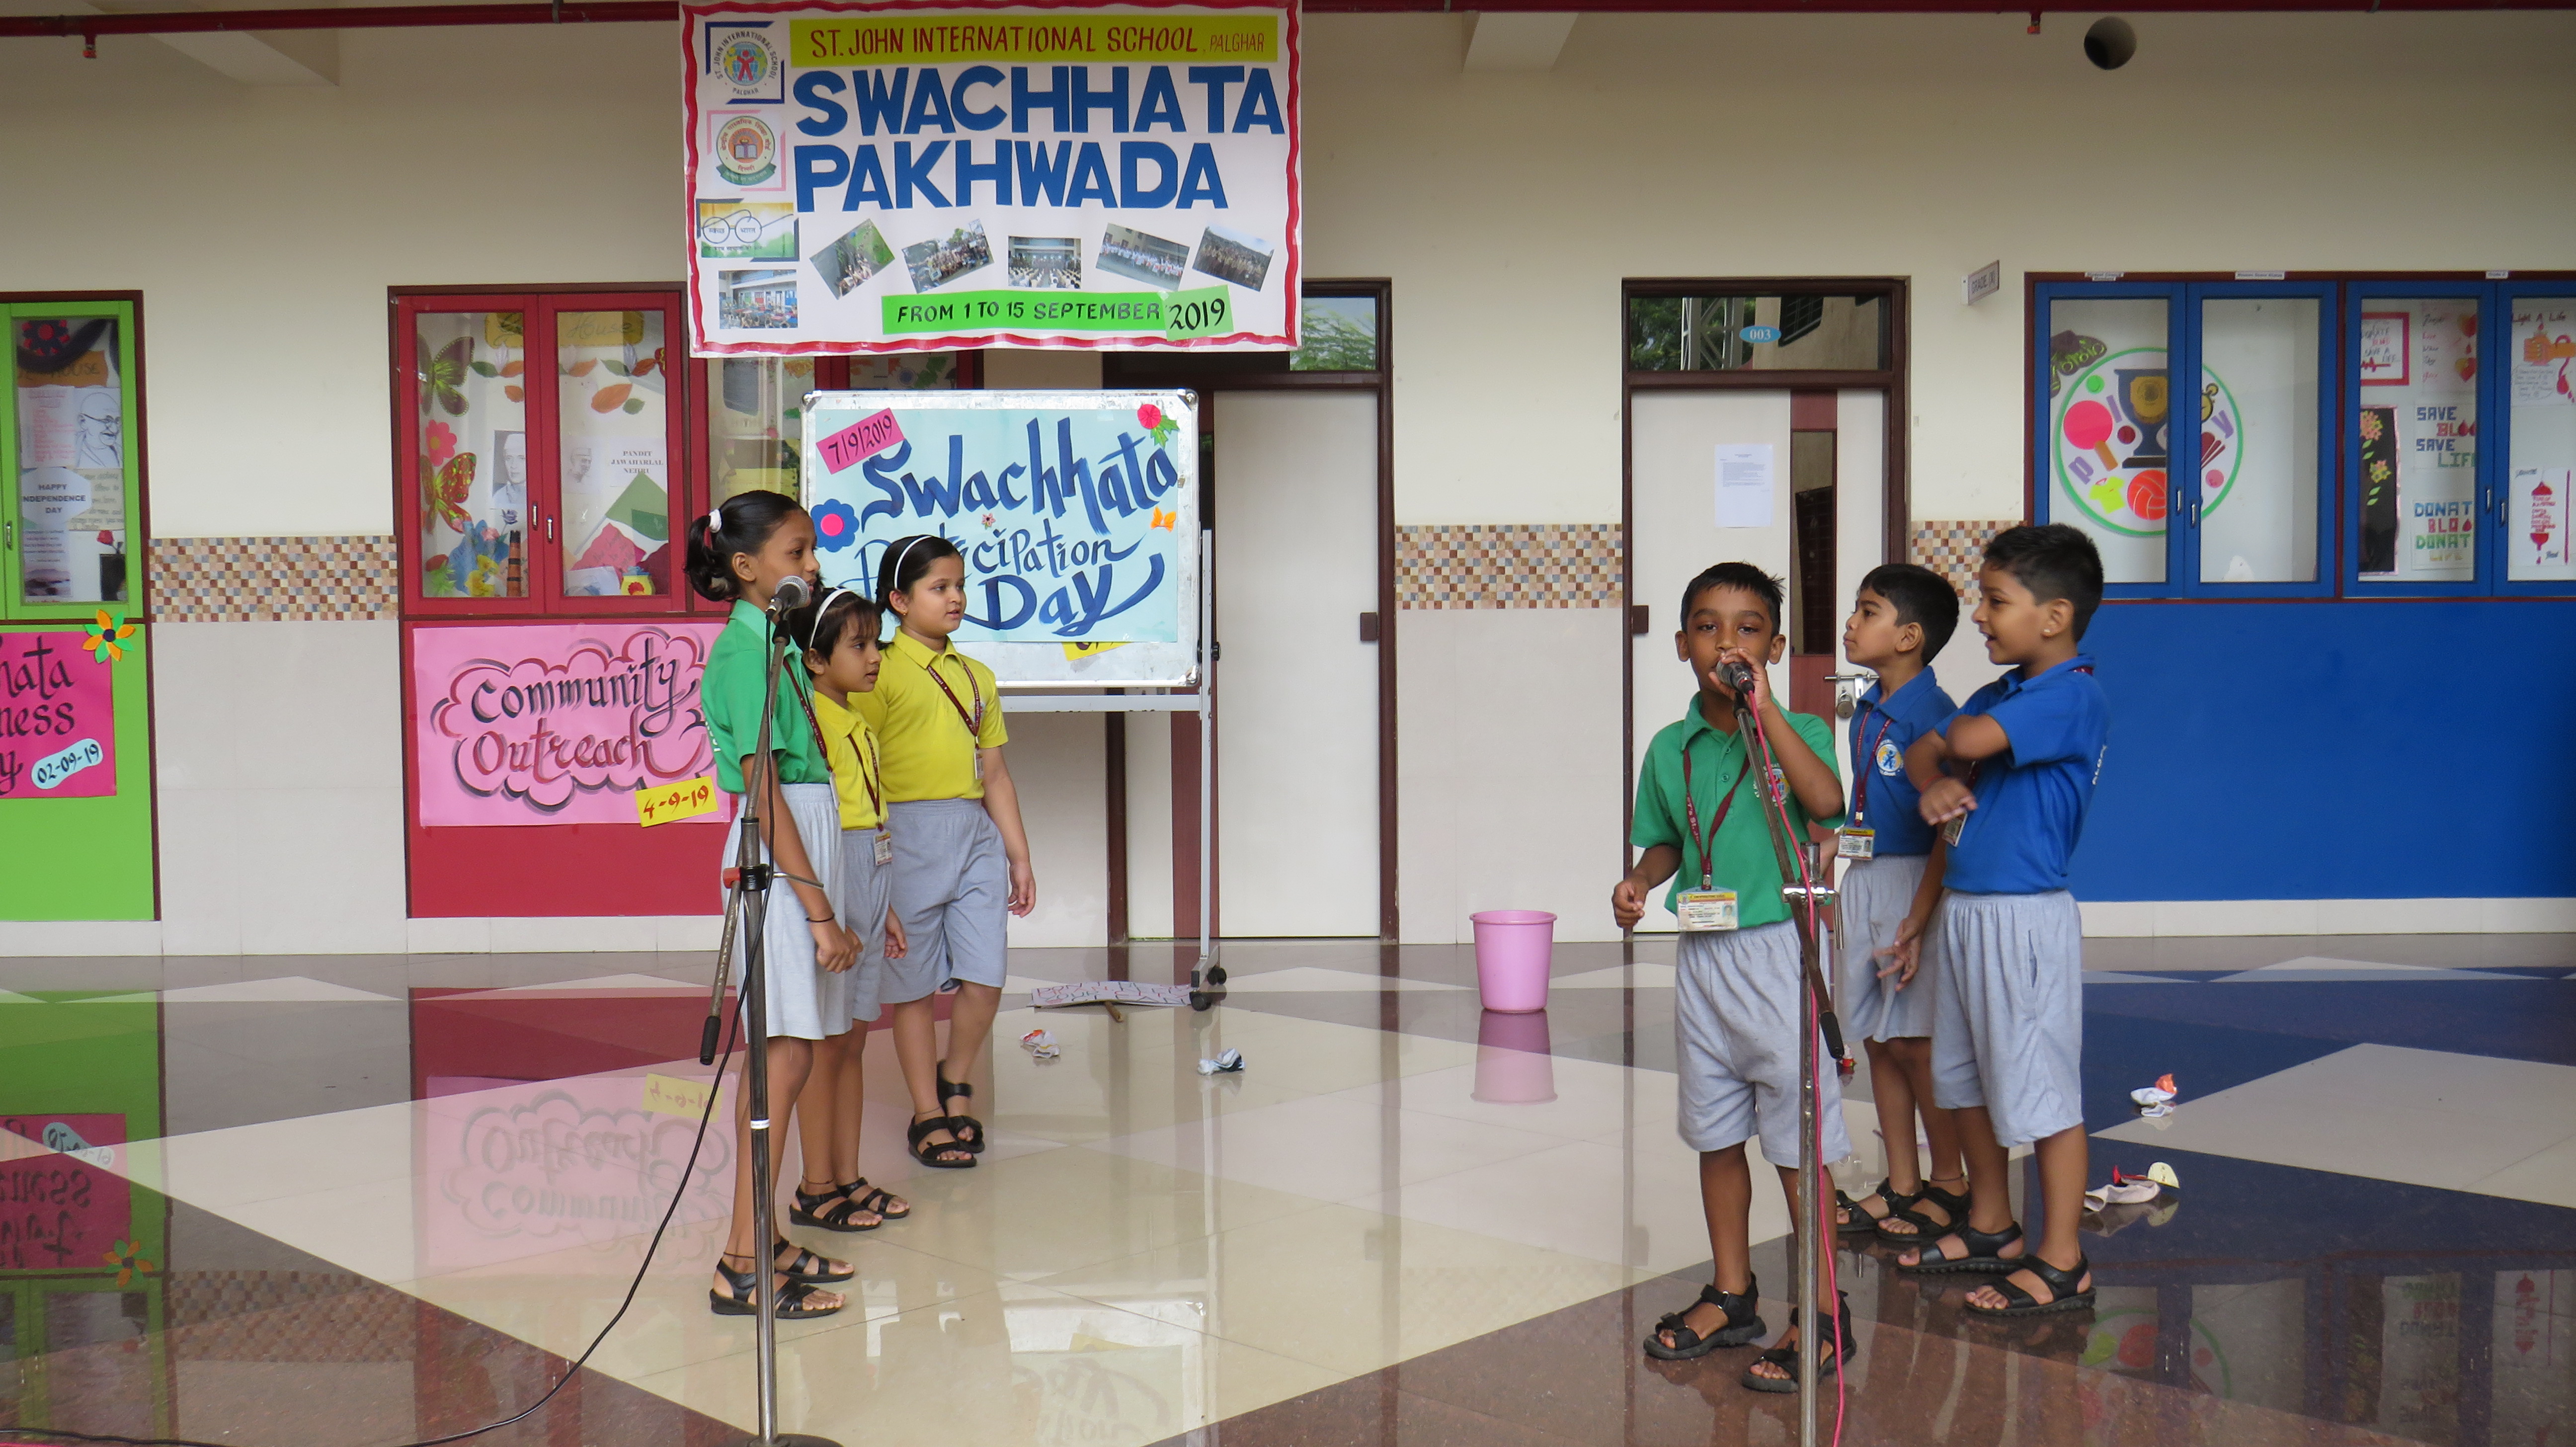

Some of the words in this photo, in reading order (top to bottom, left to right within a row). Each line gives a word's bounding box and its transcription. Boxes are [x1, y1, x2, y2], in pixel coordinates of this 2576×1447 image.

[713, 46, 724, 66] JOHN
[722, 31, 771, 51] INTERNATIONAL
[769, 51, 779, 79] SCHOOL
[810, 30, 844, 57] ST.
[848, 28, 904, 55] JOHN
[912, 26, 1096, 54] INTERNATIONAL
[1209, 33, 1266, 54] PALGHAR
[732, 87, 759, 96] PALGHAR
[793, 65, 1285, 137] SWACHHATA
[795, 139, 1229, 213] PAKHWADA
[897, 304, 954, 323] FROM
[964, 303, 970, 320] 1
[976, 301, 999, 318] TO
[1006, 301, 1024, 318] 15
[1033, 302, 1160, 321] SEPTEMBER
[1168, 298, 1226, 332] 2019
[1749, 328, 1771, 341] 003
[2416, 406, 2457, 420] SAVE
[828, 414, 892, 466] 7/9/2019
[2416, 438, 2456, 451] SAVE
[861, 416, 1178, 535] Swachhata
[839, 518, 1146, 599] Pcipation
[964, 552, 1166, 637] Day
[471, 637, 698, 737] Community
[37, 743, 99, 784] 02-09-19
[472, 704, 705, 784] Outreach
[643, 785, 710, 820] 4-9-19
